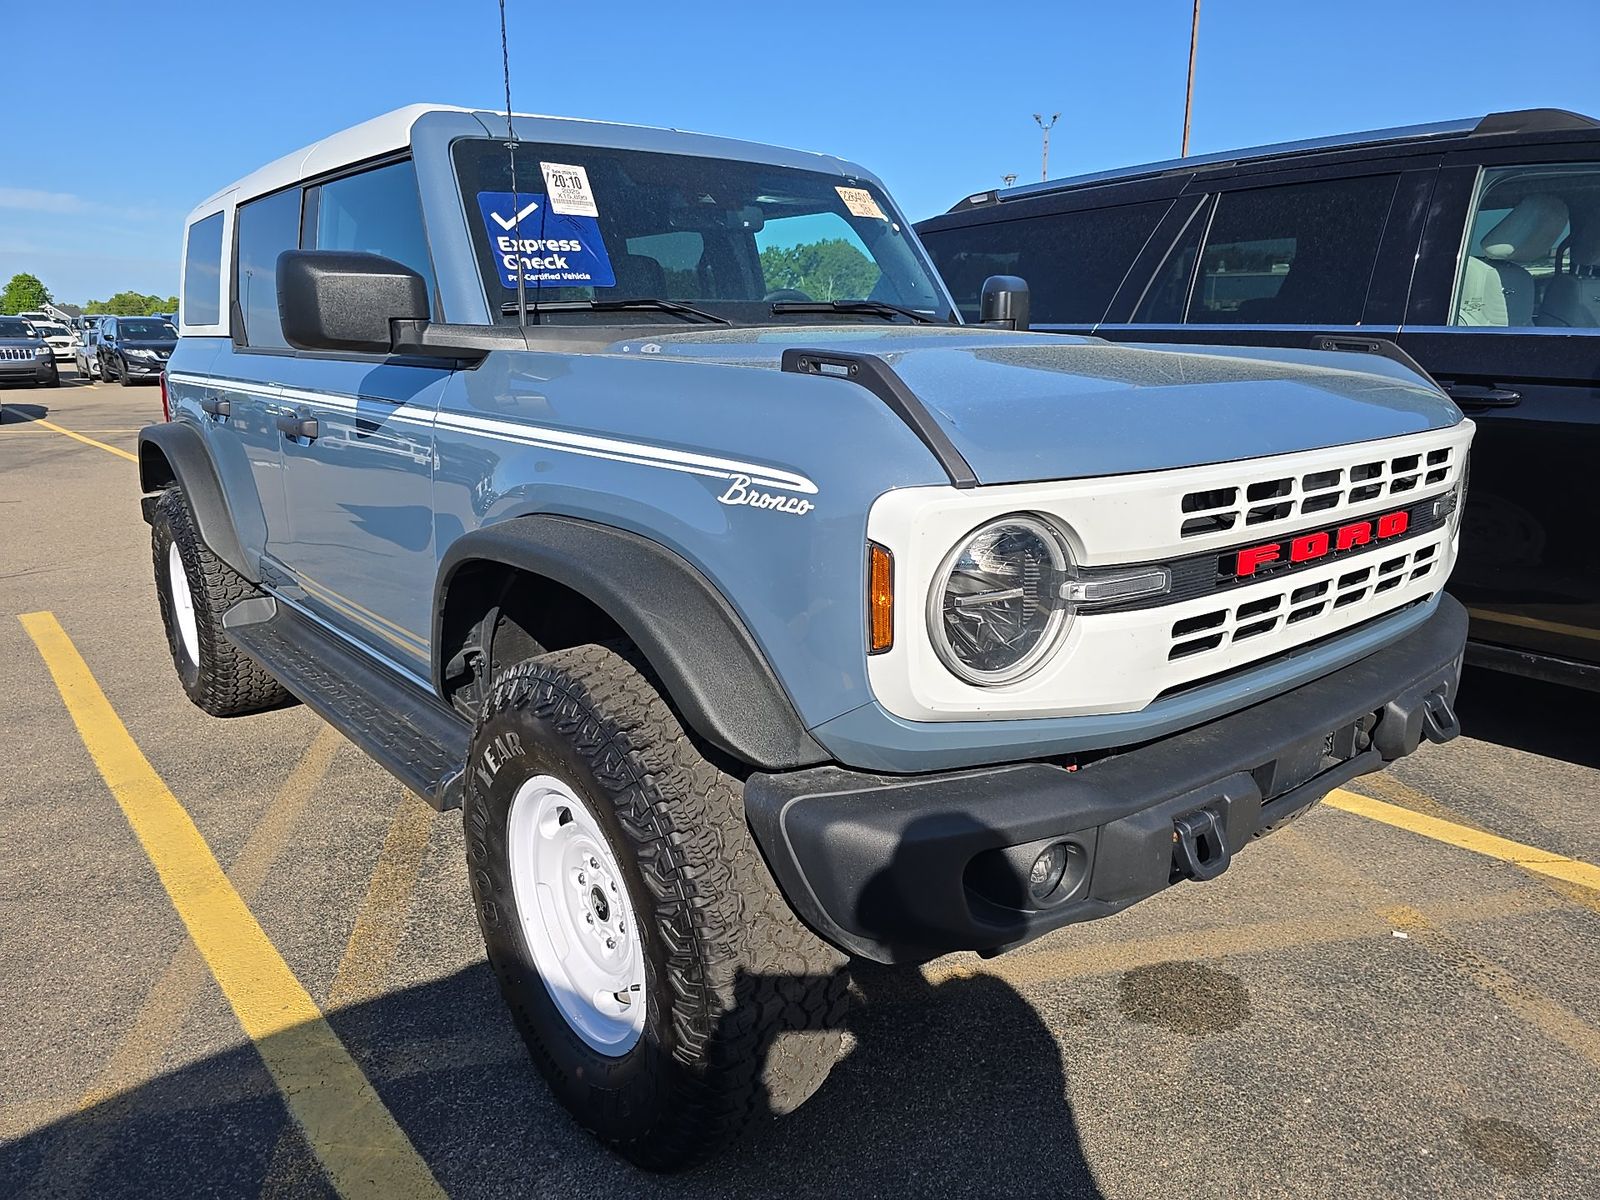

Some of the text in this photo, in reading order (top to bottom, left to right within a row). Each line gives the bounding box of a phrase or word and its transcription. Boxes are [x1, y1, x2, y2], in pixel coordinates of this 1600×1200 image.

[552, 173, 582, 189] 20:10
[497, 236, 582, 255] Express
[503, 253, 569, 270] Check
[507, 272, 592, 282] Pr-Certified Vehicle
[717, 473, 815, 516] Bronco
[1236, 511, 1409, 576] FORD
[476, 731, 526, 789] YEAR
